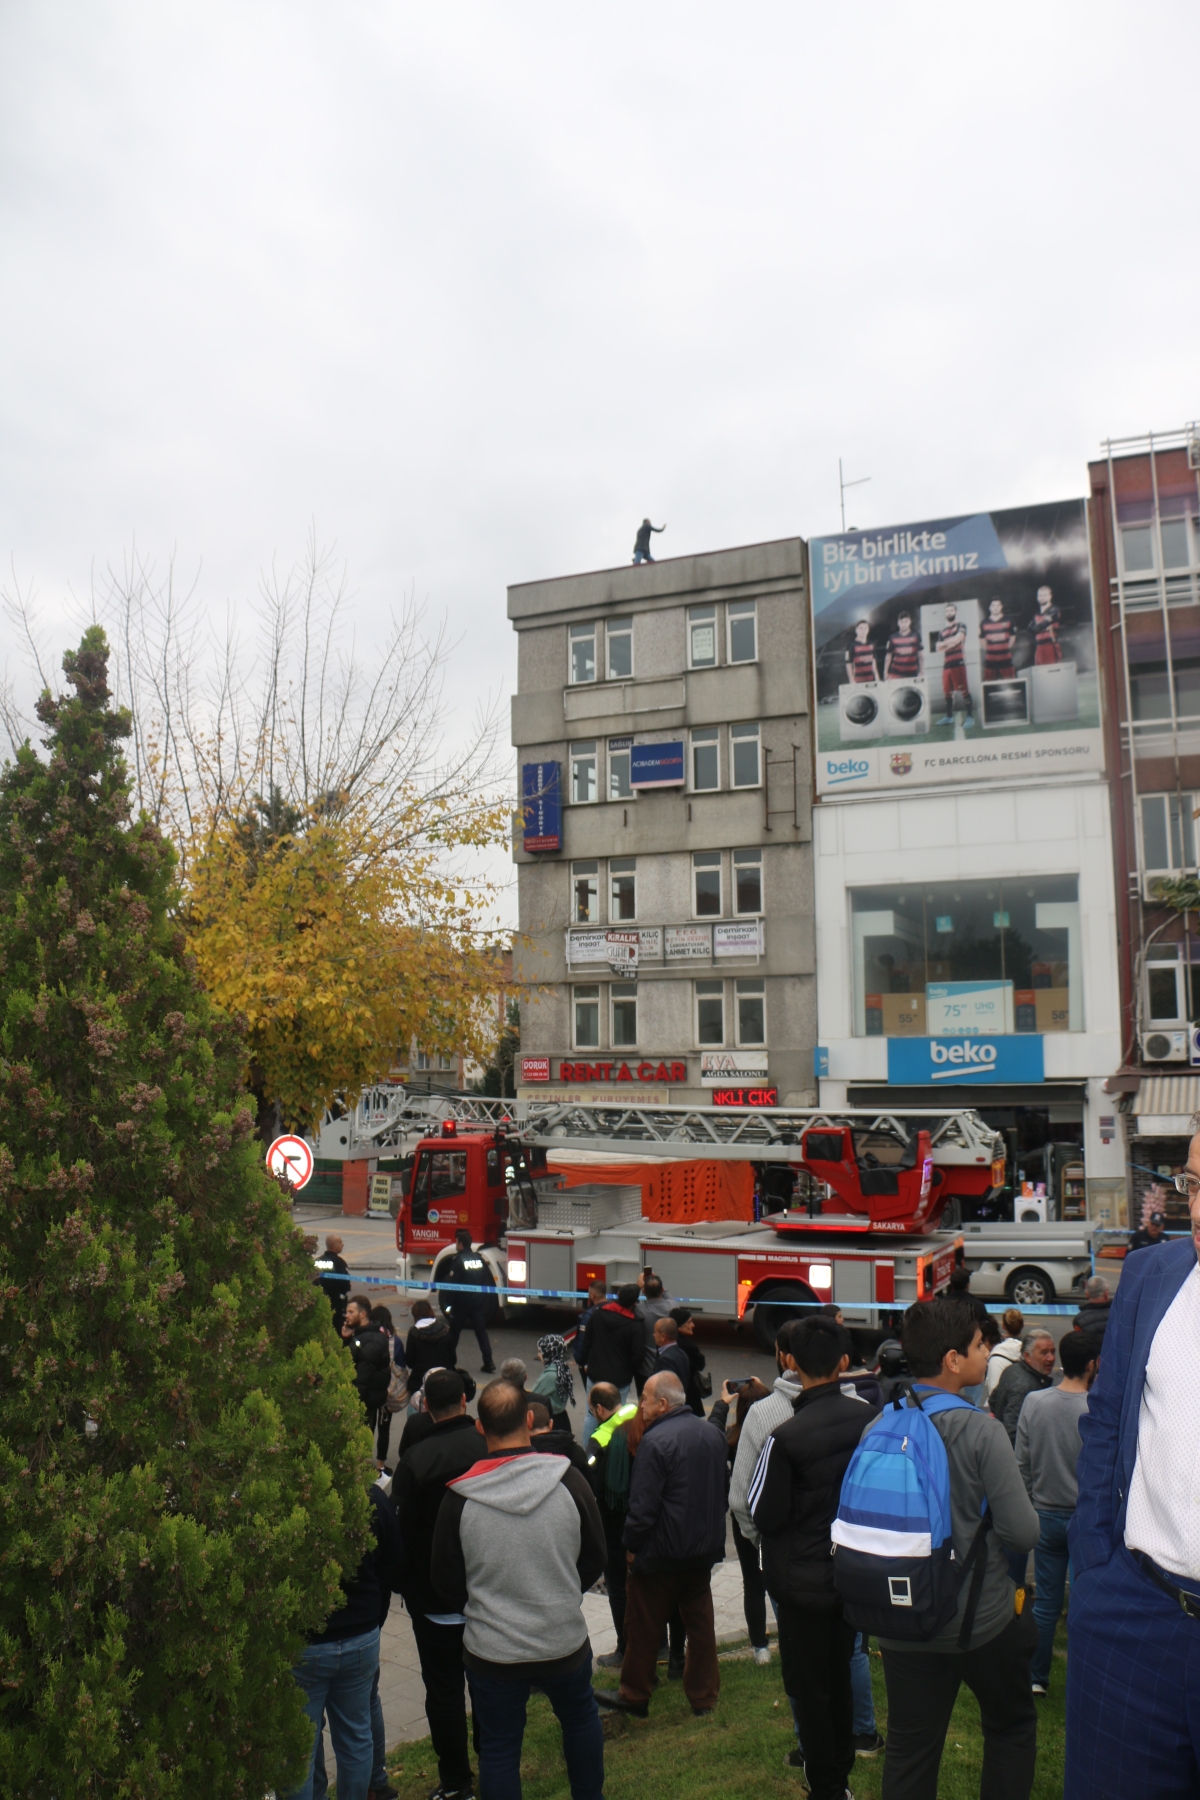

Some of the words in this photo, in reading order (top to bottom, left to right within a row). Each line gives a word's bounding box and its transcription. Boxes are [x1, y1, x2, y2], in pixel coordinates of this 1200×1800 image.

[823, 540, 857, 564] Biz
[861, 530, 946, 558] birlikte
[823, 565, 850, 593] iyi
[854, 560, 886, 585] bir
[889, 551, 979, 581] takımız
[924, 758, 936, 768] FC
[938, 753, 998, 767] BARCELONA
[1034, 745, 1090, 758] SPONSORU
[827, 758, 869, 776] beko
[929, 987, 948, 995] beko
[974, 1002, 995, 1010] UHD
[930, 1040, 998, 1065] beko
[523, 1061, 547, 1070] DORUK
[701, 1053, 738, 1070] EVA
[559, 1062, 613, 1083] RENT
[616, 1062, 632, 1083] A
[637, 1061, 687, 1083] CAR
[412, 1228, 439, 1238] YANGIN
[872, 1221, 906, 1231] SAKARYA
[768, 1255, 798, 1263] MAGIRUS
